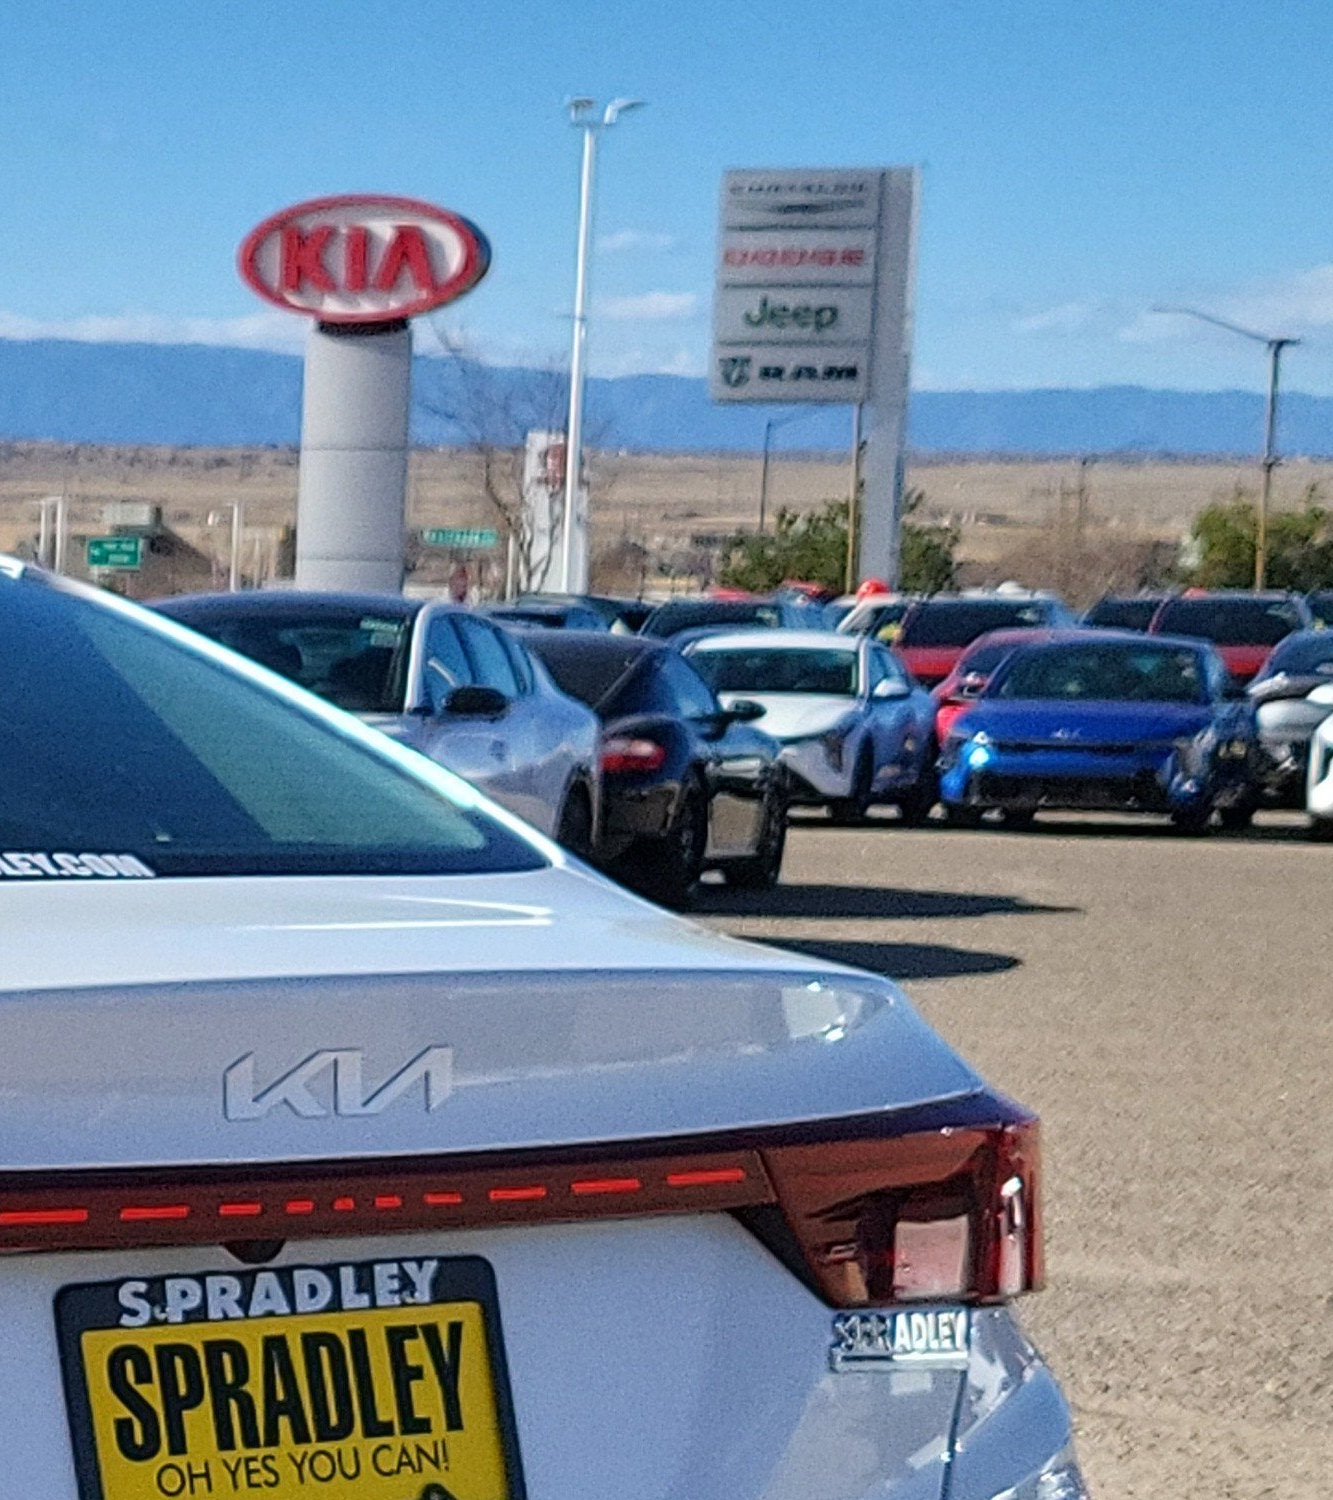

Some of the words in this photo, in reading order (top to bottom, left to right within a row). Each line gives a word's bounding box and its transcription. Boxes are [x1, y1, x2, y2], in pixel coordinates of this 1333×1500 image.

[284, 225, 433, 293] KIA
[744, 296, 838, 333] Jeep
[758, 364, 858, 382] RAM
[222, 1043, 454, 1123] KIA
[118, 1260, 438, 1328] SPRADLEY
[106, 1320, 465, 1462] SPRADLEY
[156, 1458, 213, 1499] OH
[221, 1453, 279, 1492] YES
[290, 1446, 361, 1486] YOU
[373, 1439, 451, 1477] CAN!
